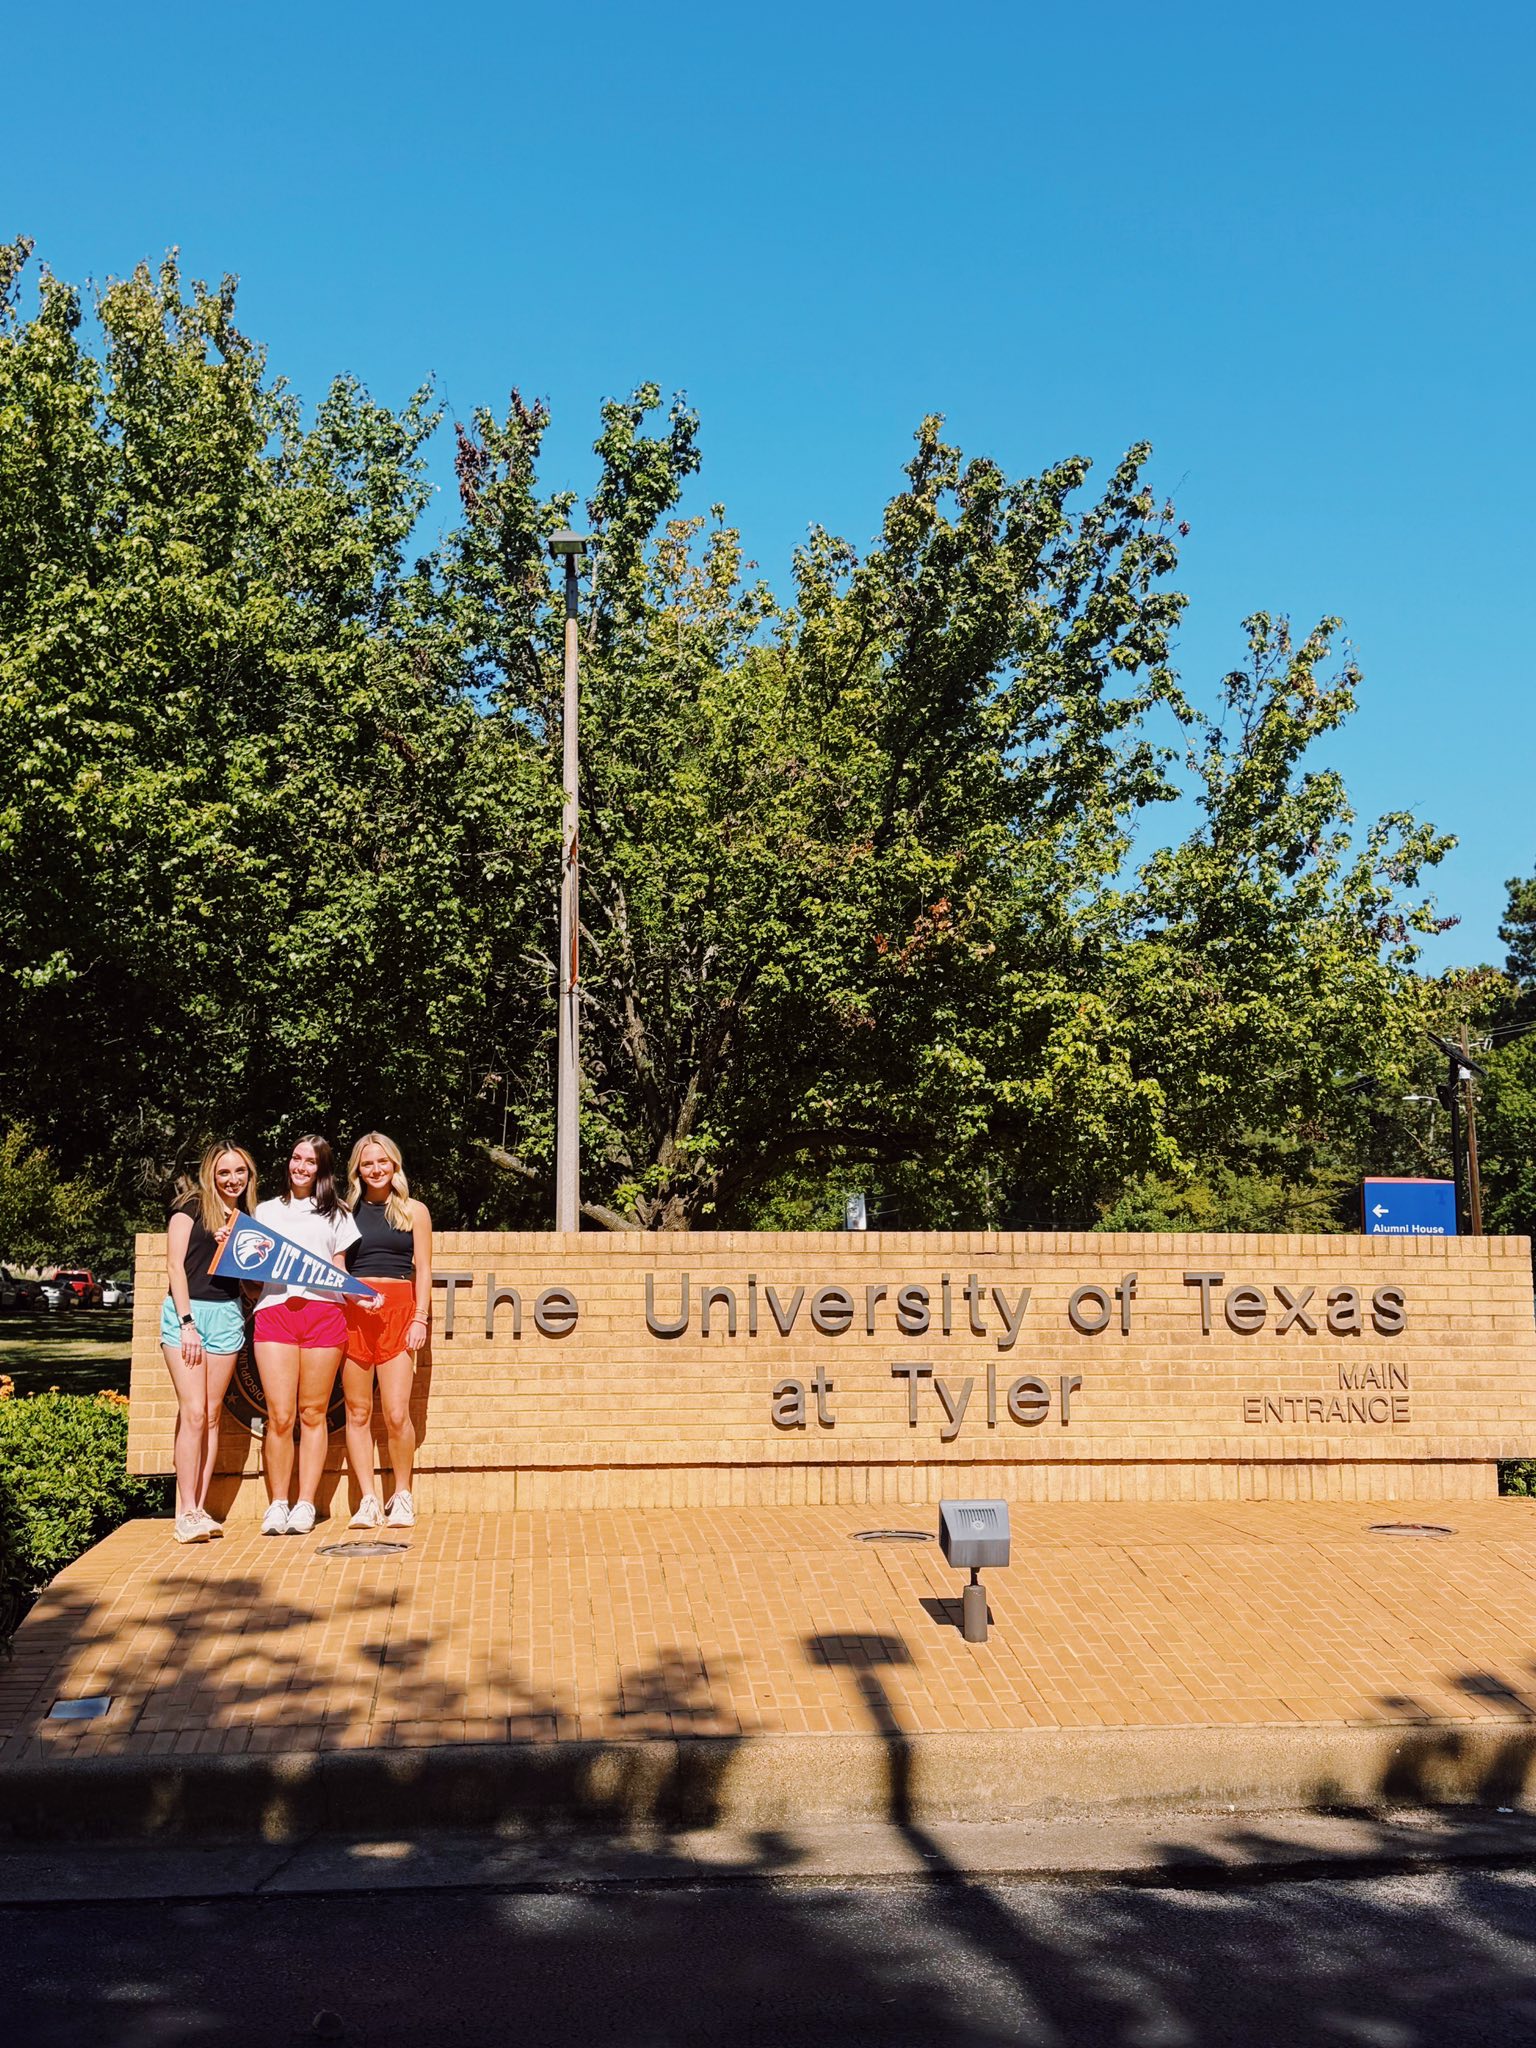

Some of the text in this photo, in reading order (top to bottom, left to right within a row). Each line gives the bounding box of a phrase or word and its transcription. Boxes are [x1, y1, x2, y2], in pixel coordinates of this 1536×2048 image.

[1373, 1223, 1445, 1234] Alumni House
[271, 1241, 347, 1289] UT TYLER
[431, 1272, 1408, 1352] The University of Texas
[1337, 1362, 1409, 1390] MAIN
[772, 1363, 1082, 1443] at Tyler
[1243, 1396, 1411, 1423] ENTRANCE
